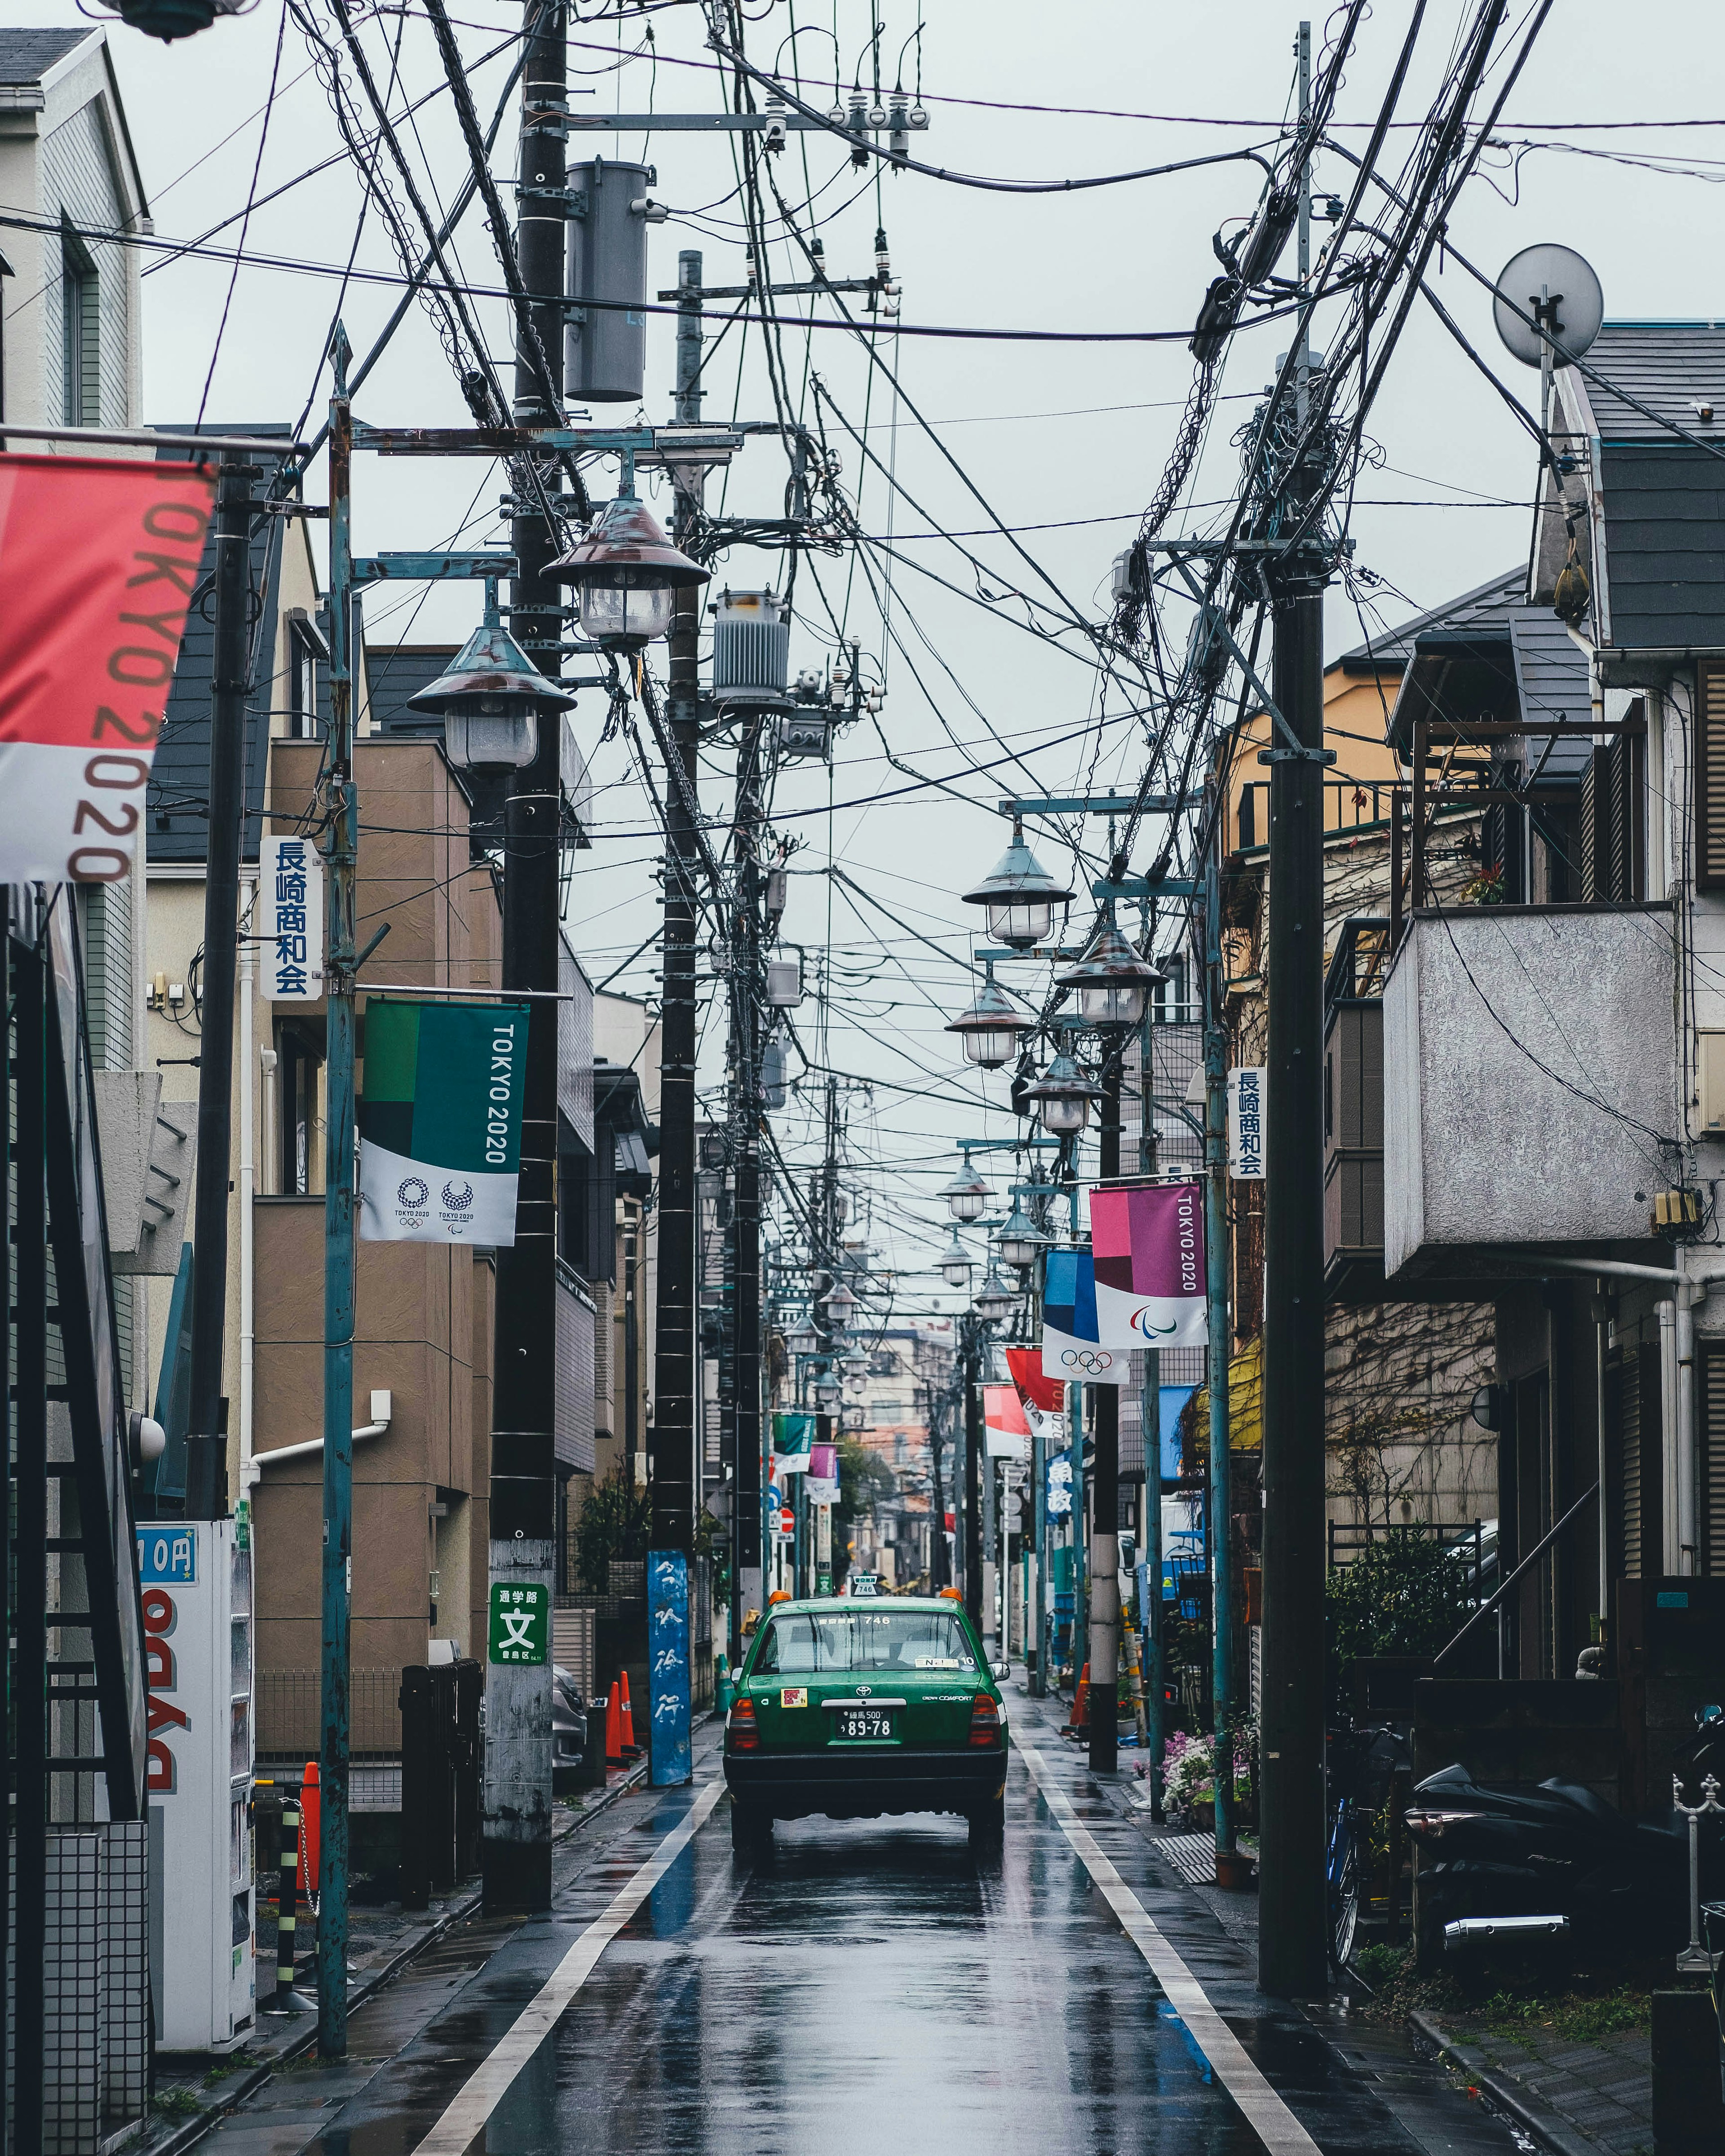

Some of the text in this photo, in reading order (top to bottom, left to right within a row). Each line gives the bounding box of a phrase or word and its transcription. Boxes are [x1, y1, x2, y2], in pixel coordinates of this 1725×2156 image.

[68, 472, 217, 884] TOKYO 2020
[275, 841, 308, 996] 長崎商和会
[485, 1024, 514, 1164] TOKYO 2020
[1238, 1071, 1261, 1175] 長崎商和会
[1177, 1195, 1197, 1292] TOKYO 2020
[499, 1590, 537, 1604] 通学路
[498, 1607, 536, 1649] 文
[864, 1617, 890, 1625] 746
[502, 1650, 530, 1659] 豊島区
[961, 1656, 974, 1666] 10
[840, 1720, 890, 1736] う 89-78
[849, 1711, 881, 1719] 練馬 500
